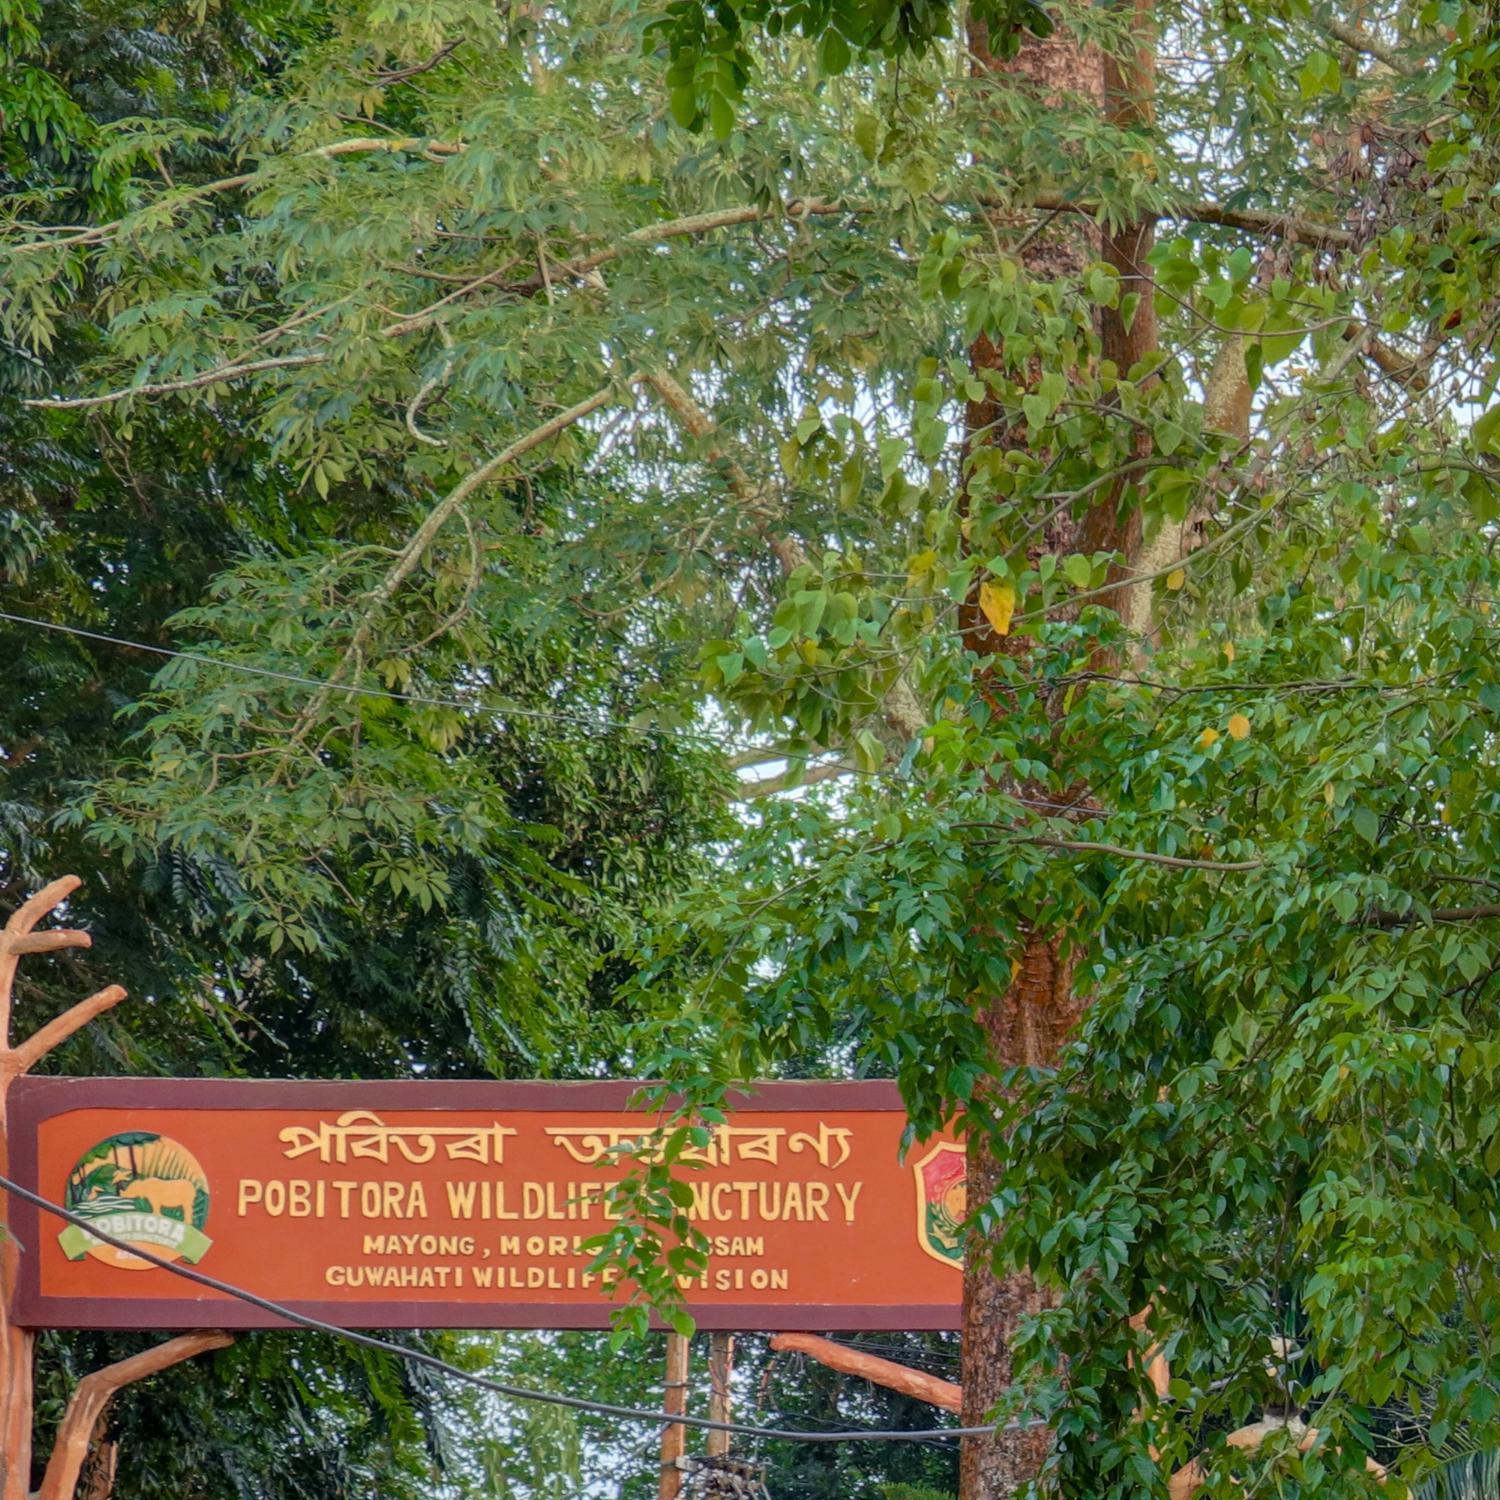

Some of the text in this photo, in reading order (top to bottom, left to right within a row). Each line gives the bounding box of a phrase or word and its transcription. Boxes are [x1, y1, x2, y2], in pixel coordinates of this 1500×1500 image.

[278, 1110, 518, 1165] পবিতৰা
[237, 1180, 428, 1220] POBITORA
[641, 1180, 863, 1223] NCTUARY
[325, 1265, 464, 1288] GUWAHATI
[638, 1267, 789, 1291] VISION
